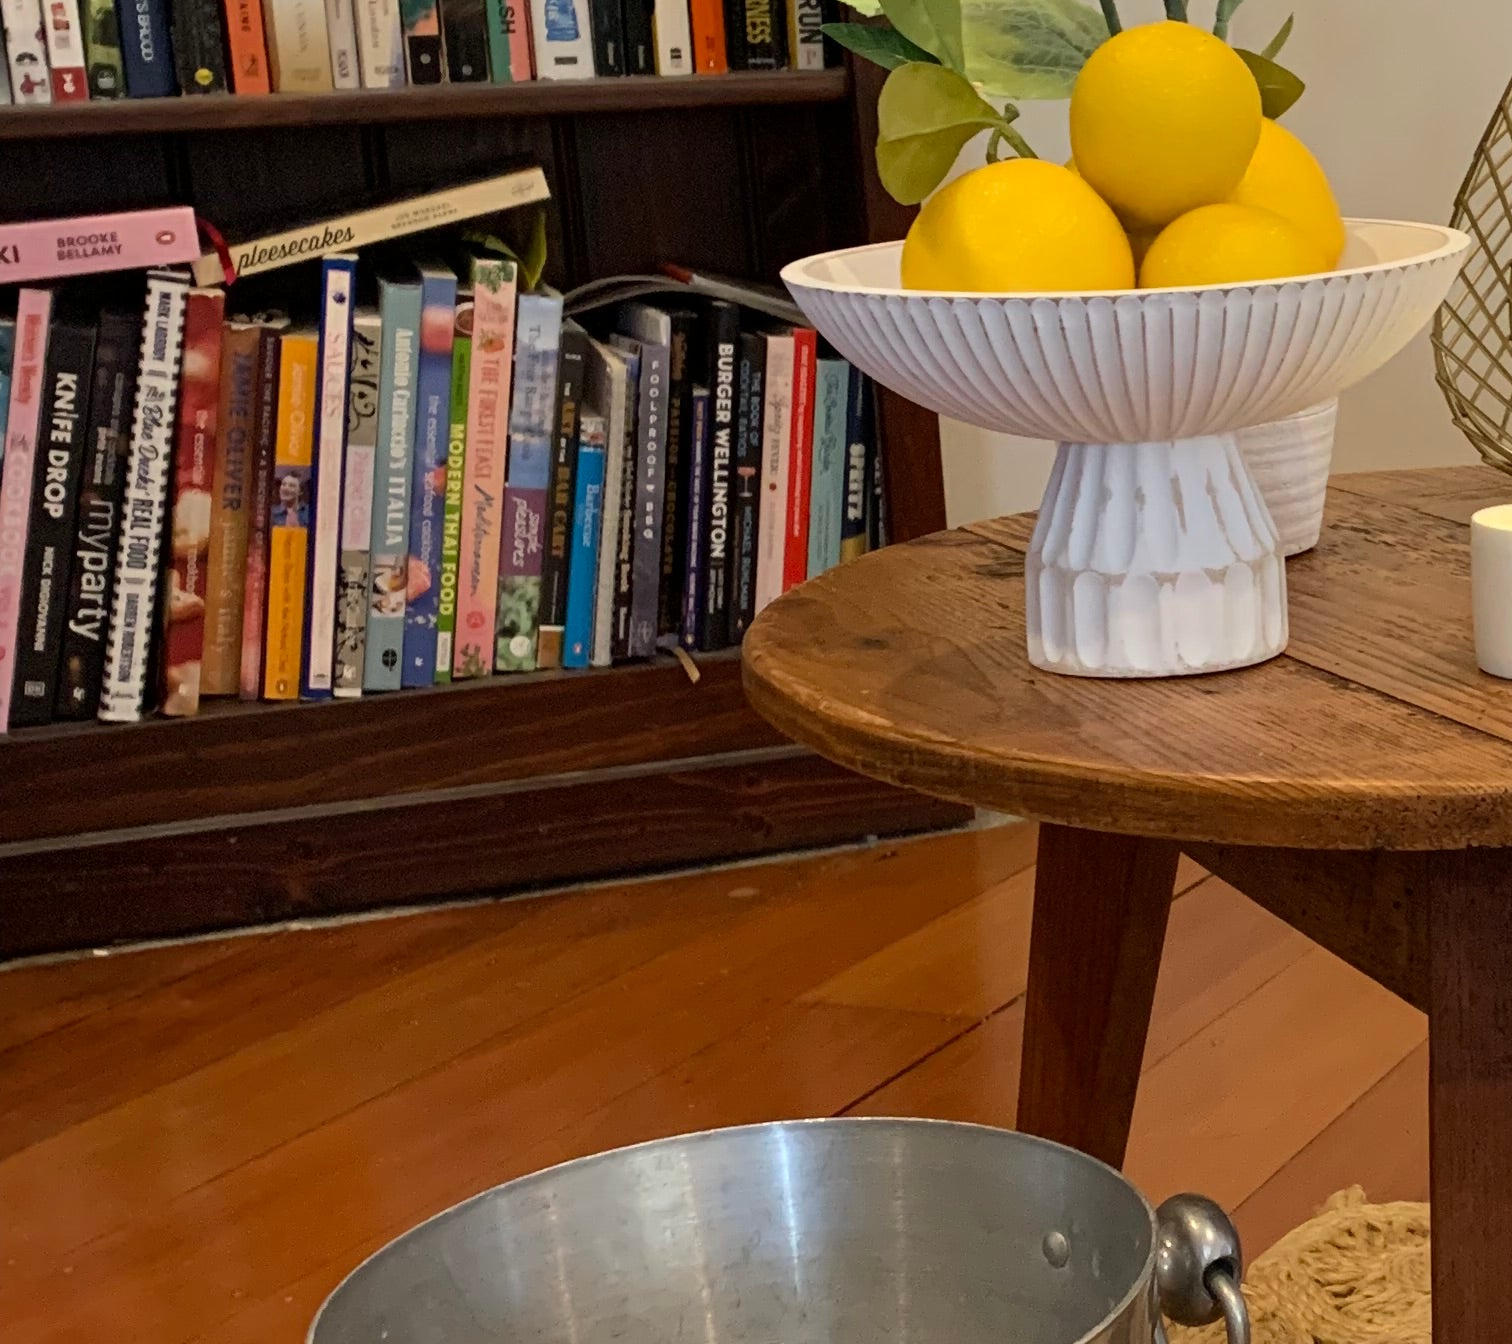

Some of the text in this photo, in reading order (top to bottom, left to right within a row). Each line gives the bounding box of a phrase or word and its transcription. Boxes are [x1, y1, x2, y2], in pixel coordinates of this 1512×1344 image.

[138, 13, 155, 63] BROOD
[57, 231, 119, 249] BROOKE
[57, 242, 123, 262] BELLAMY
[237, 225, 357, 271] pleesecakes
[158, 291, 172, 318] MARK
[326, 331, 345, 418] SAUCES
[394, 327, 414, 387] Antonio
[480, 357, 500, 391] THE
[715, 342, 736, 425] BURGER
[140, 403, 165, 442] Blue
[736, 358, 751, 458] COCKTAIL RATIOS
[749, 371, 762, 428] THE BOOK
[43, 371, 79, 520] KNIFE DROP
[191, 431, 206, 485] essential
[224, 351, 253, 512] JAMIE OLIVER
[473, 439, 495, 481] FEAST
[642, 359, 660, 540] FOOLPROOF BBQ
[424, 417, 439, 517] essential seafood
[709, 426, 731, 560] WELLINGTON
[847, 441, 866, 522] SPRITZ
[129, 498, 154, 534] REAL
[385, 475, 407, 547] ITALIA
[440, 422, 465, 617] MODERN THAI FOOD
[510, 495, 527, 570] pleasures
[551, 508, 569, 559] CART
[581, 482, 600, 549] Barbecue
[41, 546, 55, 577] NICK
[126, 534, 150, 571] FOOD
